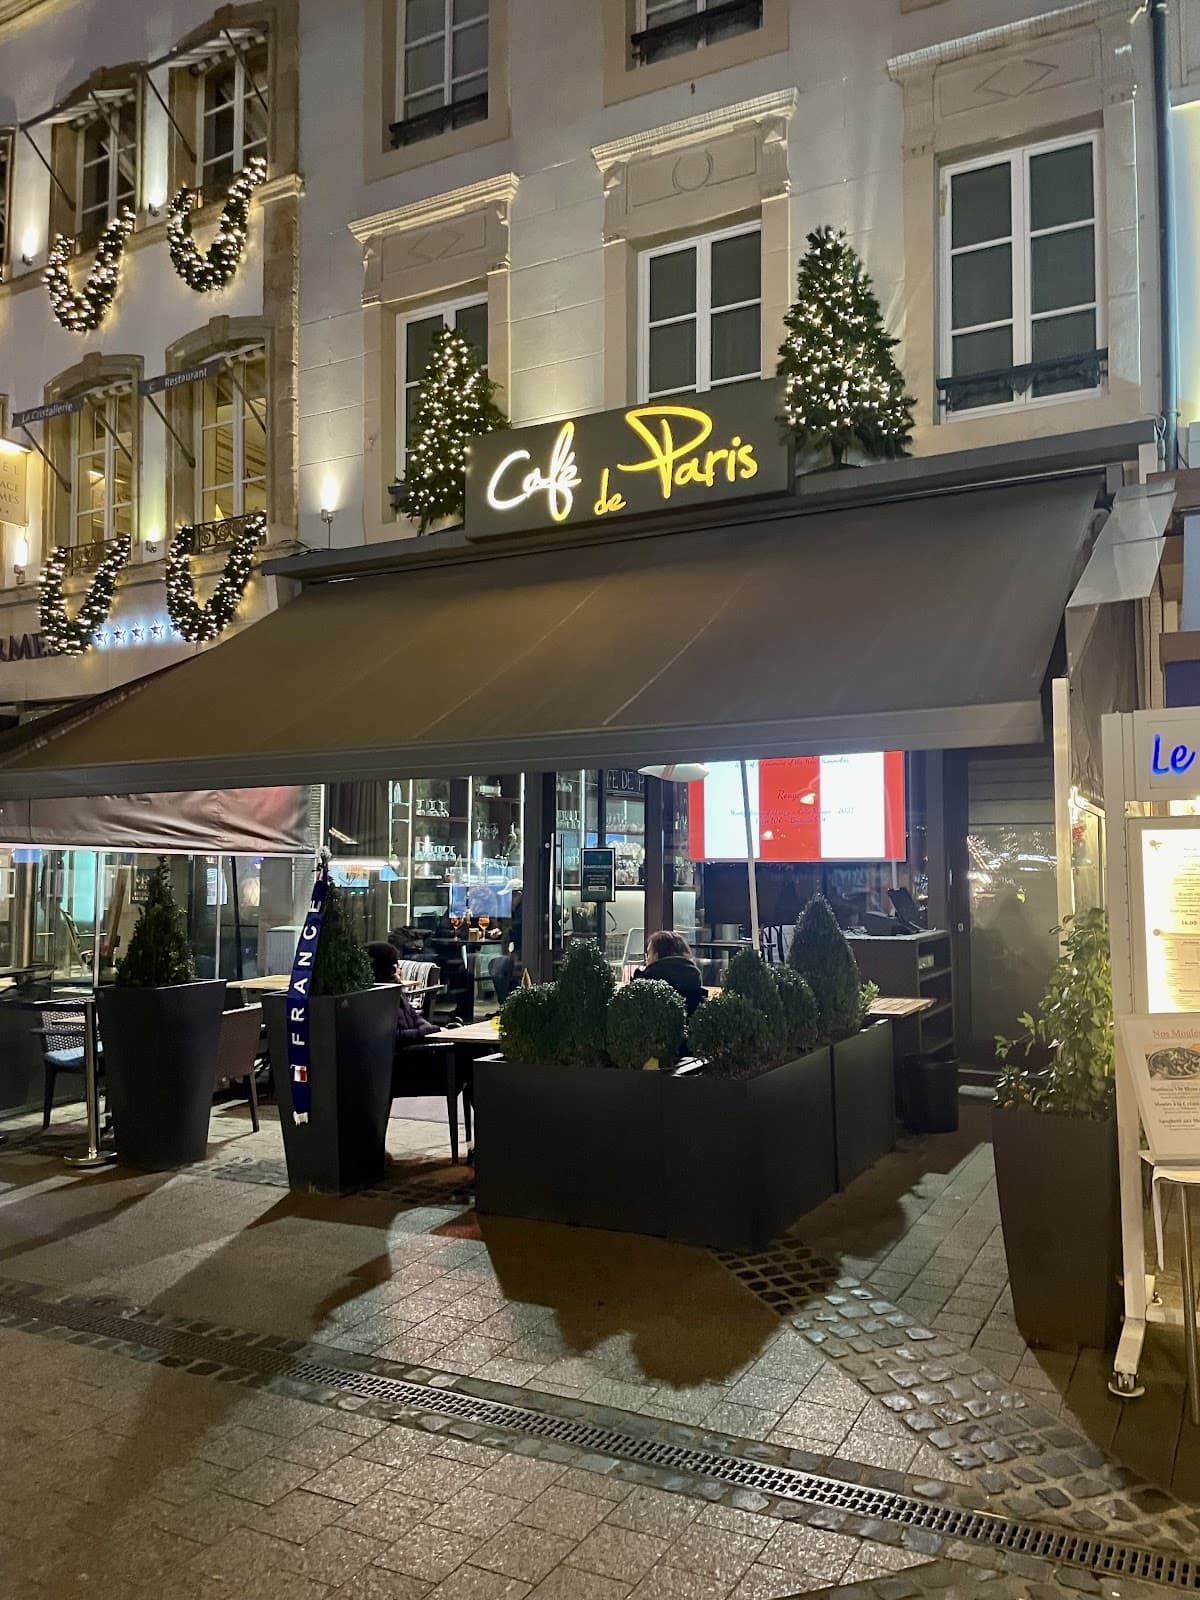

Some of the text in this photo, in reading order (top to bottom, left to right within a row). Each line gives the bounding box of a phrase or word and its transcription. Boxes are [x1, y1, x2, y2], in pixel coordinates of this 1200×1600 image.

[164, 368, 208, 387] Restaurant
[21, 402, 74, 423] La Cristallerie
[487, 405, 758, 522] Café de Paris
[1151, 733, 1196, 775] Le
[290, 899, 324, 1046] FRANCE
